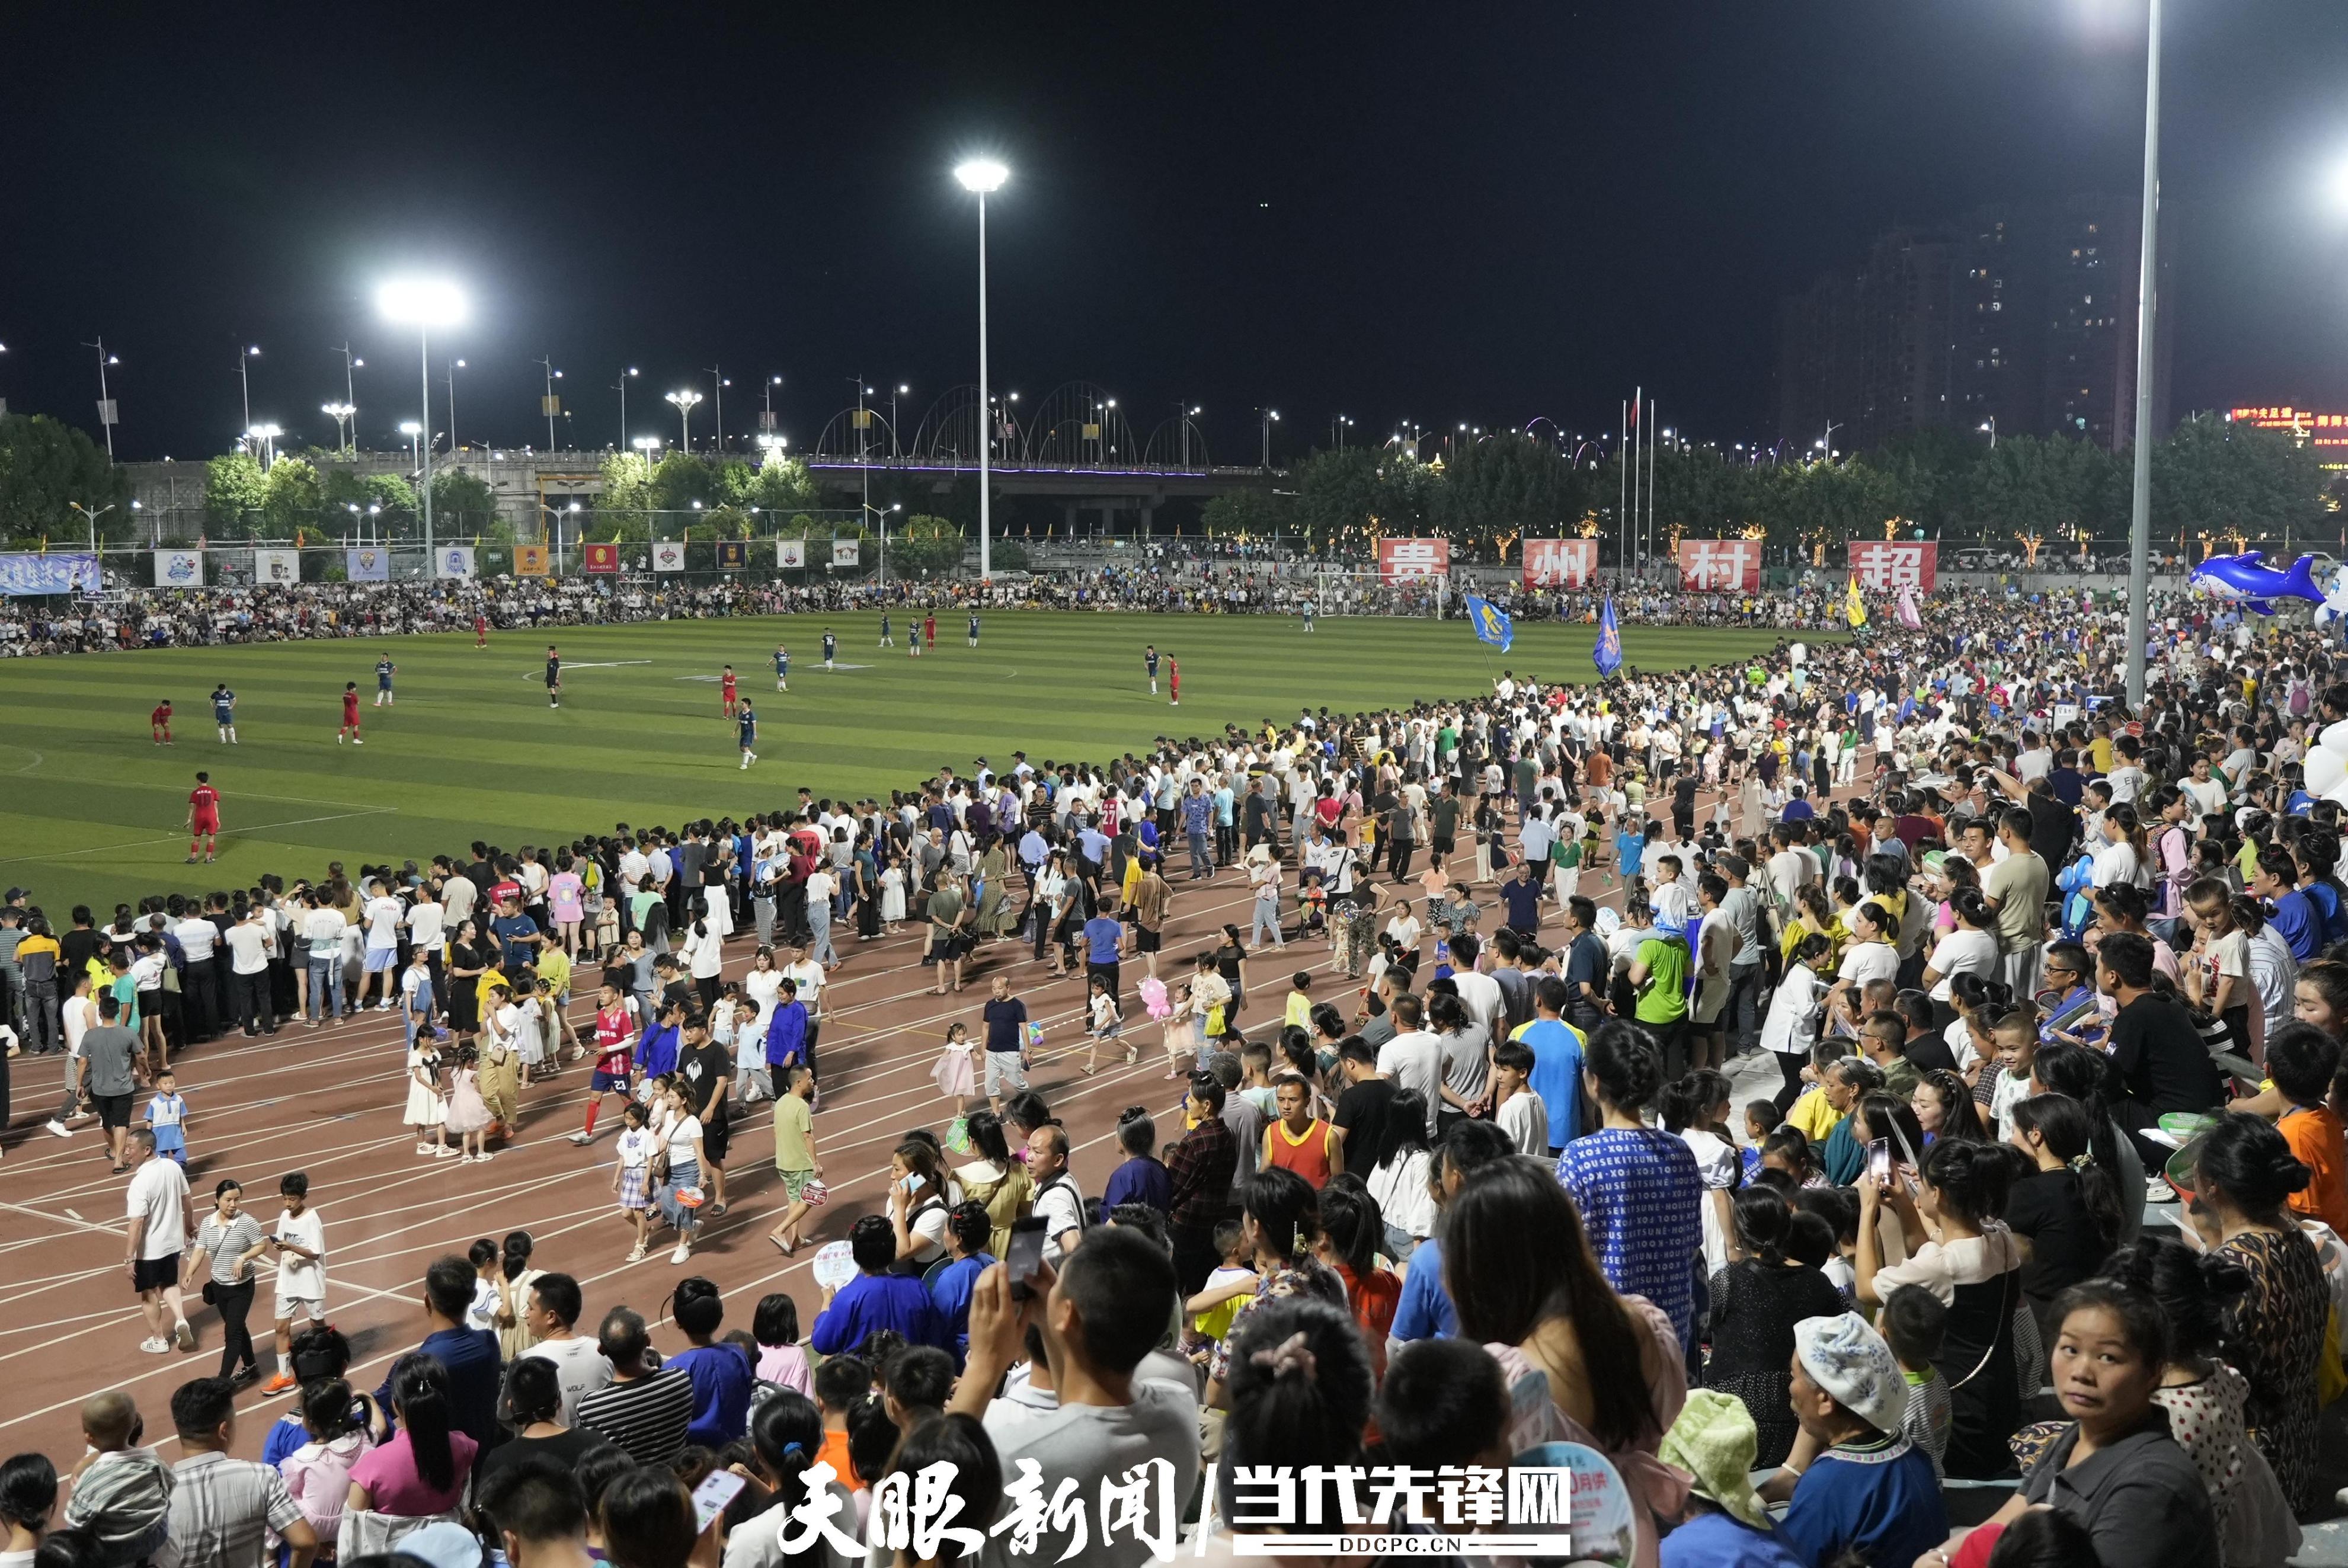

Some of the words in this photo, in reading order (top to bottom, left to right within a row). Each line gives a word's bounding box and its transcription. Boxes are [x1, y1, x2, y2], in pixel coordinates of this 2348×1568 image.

[1387, 542, 1440, 586] 贵
[1533, 544, 1588, 587] 州
[1688, 544, 1751, 590] 村
[1858, 545, 1924, 592] 超
[1102, 810, 1116, 825] 27
[614, 1080, 626, 1090] 23
[567, 1384, 586, 1393] WOLF
